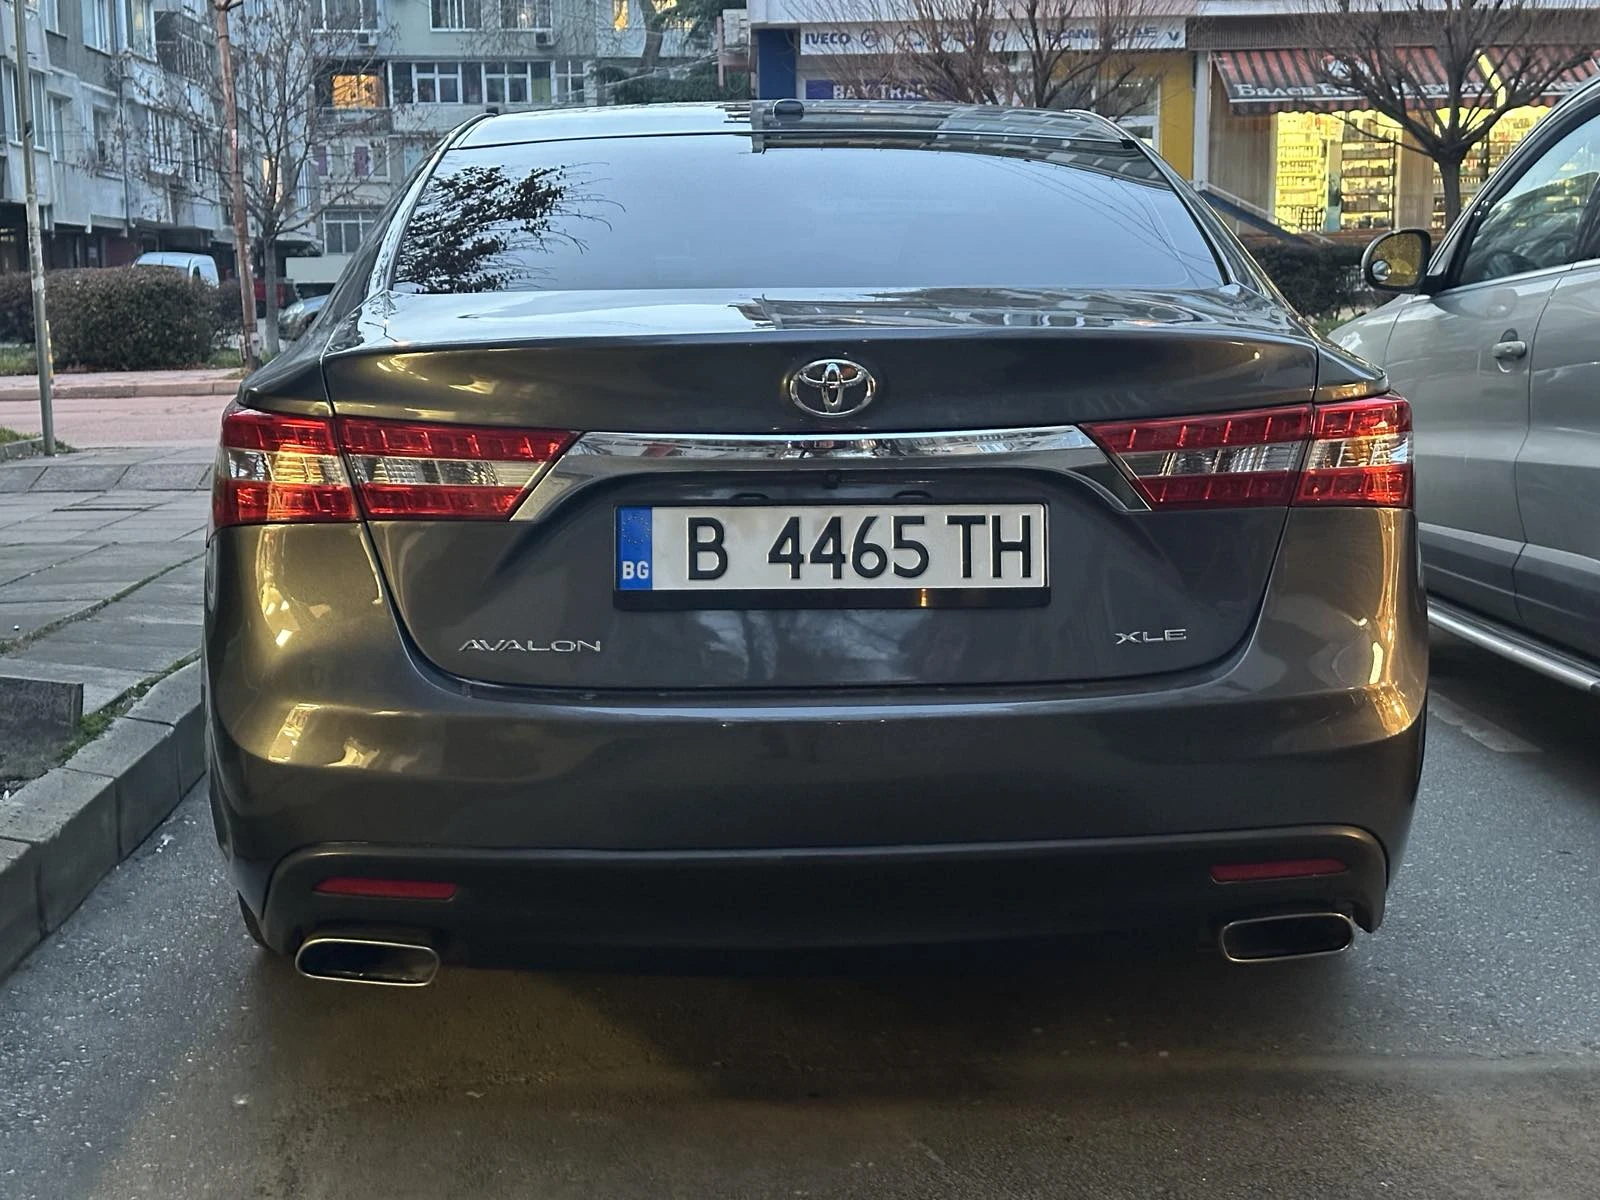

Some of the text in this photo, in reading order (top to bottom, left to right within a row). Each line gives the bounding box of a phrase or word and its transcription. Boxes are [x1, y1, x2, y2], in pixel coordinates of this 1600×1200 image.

[804, 32, 851, 46] IVECO
[1233, 83, 1316, 97] Балев
[687, 514, 1032, 581] B 4465 TH
[621, 560, 650, 580] BG
[1114, 628, 1187, 645] XLE
[457, 639, 601, 652] AVALON
